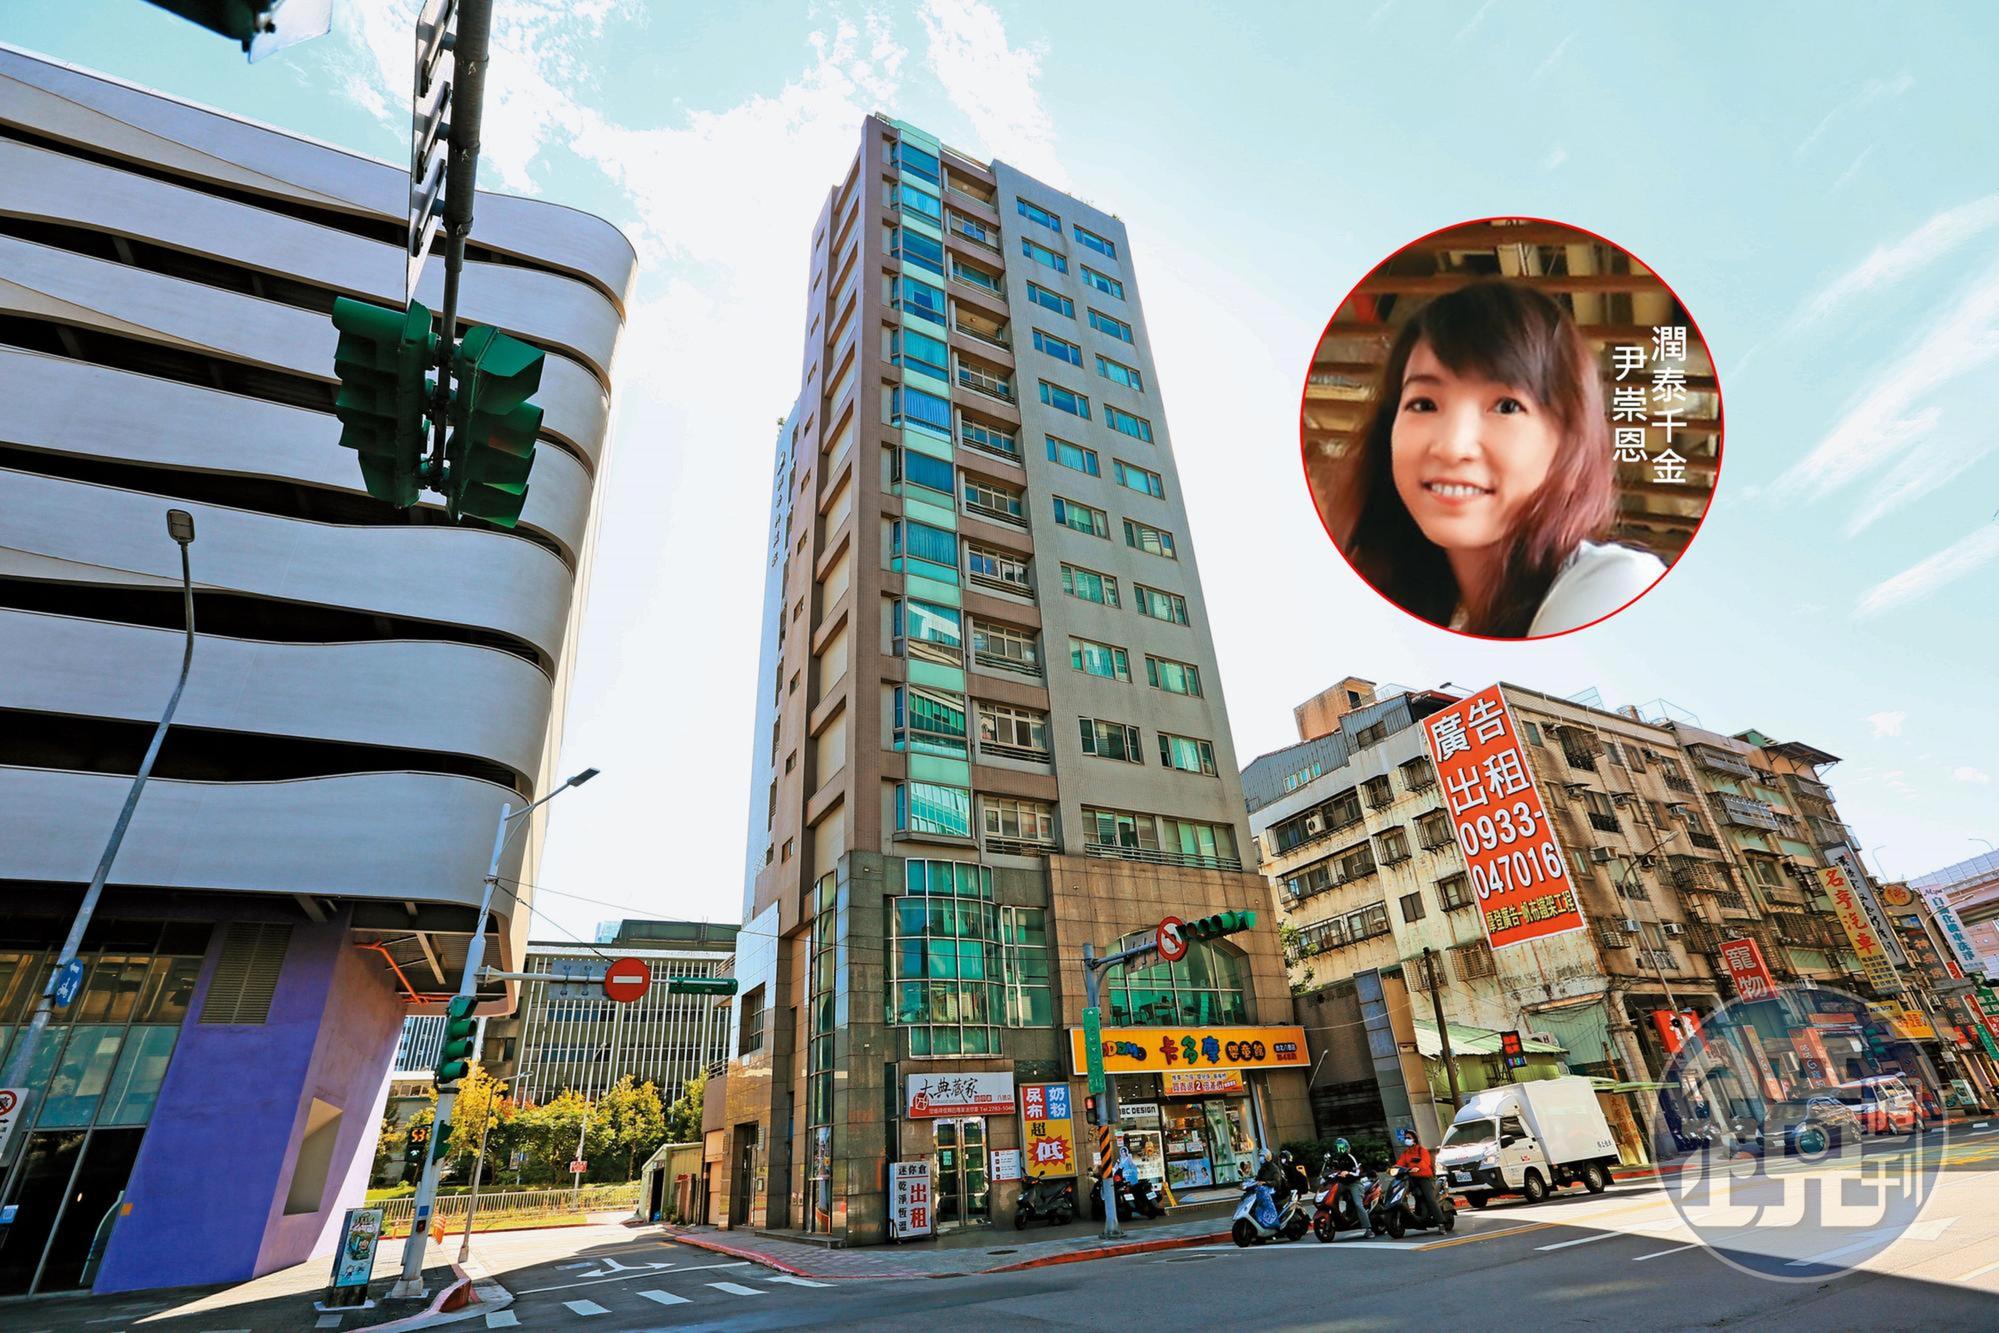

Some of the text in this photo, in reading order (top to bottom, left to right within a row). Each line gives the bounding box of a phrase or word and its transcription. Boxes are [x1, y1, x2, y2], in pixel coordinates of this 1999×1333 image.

[1431, 698, 1506, 763] 廣告
[1446, 748, 1531, 816] 出租
[1460, 801, 1545, 856] 0933-
[1472, 842, 1564, 900] 047016
[1725, 946, 1768, 999] 寵物
[1159, 1035, 1220, 1065] 卡多摩
[1026, 1087, 1043, 1118] 尿布
[1048, 1087, 1067, 1117] 奶粉
[1132, 1105, 1156, 1115] DESIGN
[411, 1128, 427, 1142] 53
[910, 1182, 928, 1228] 出租
